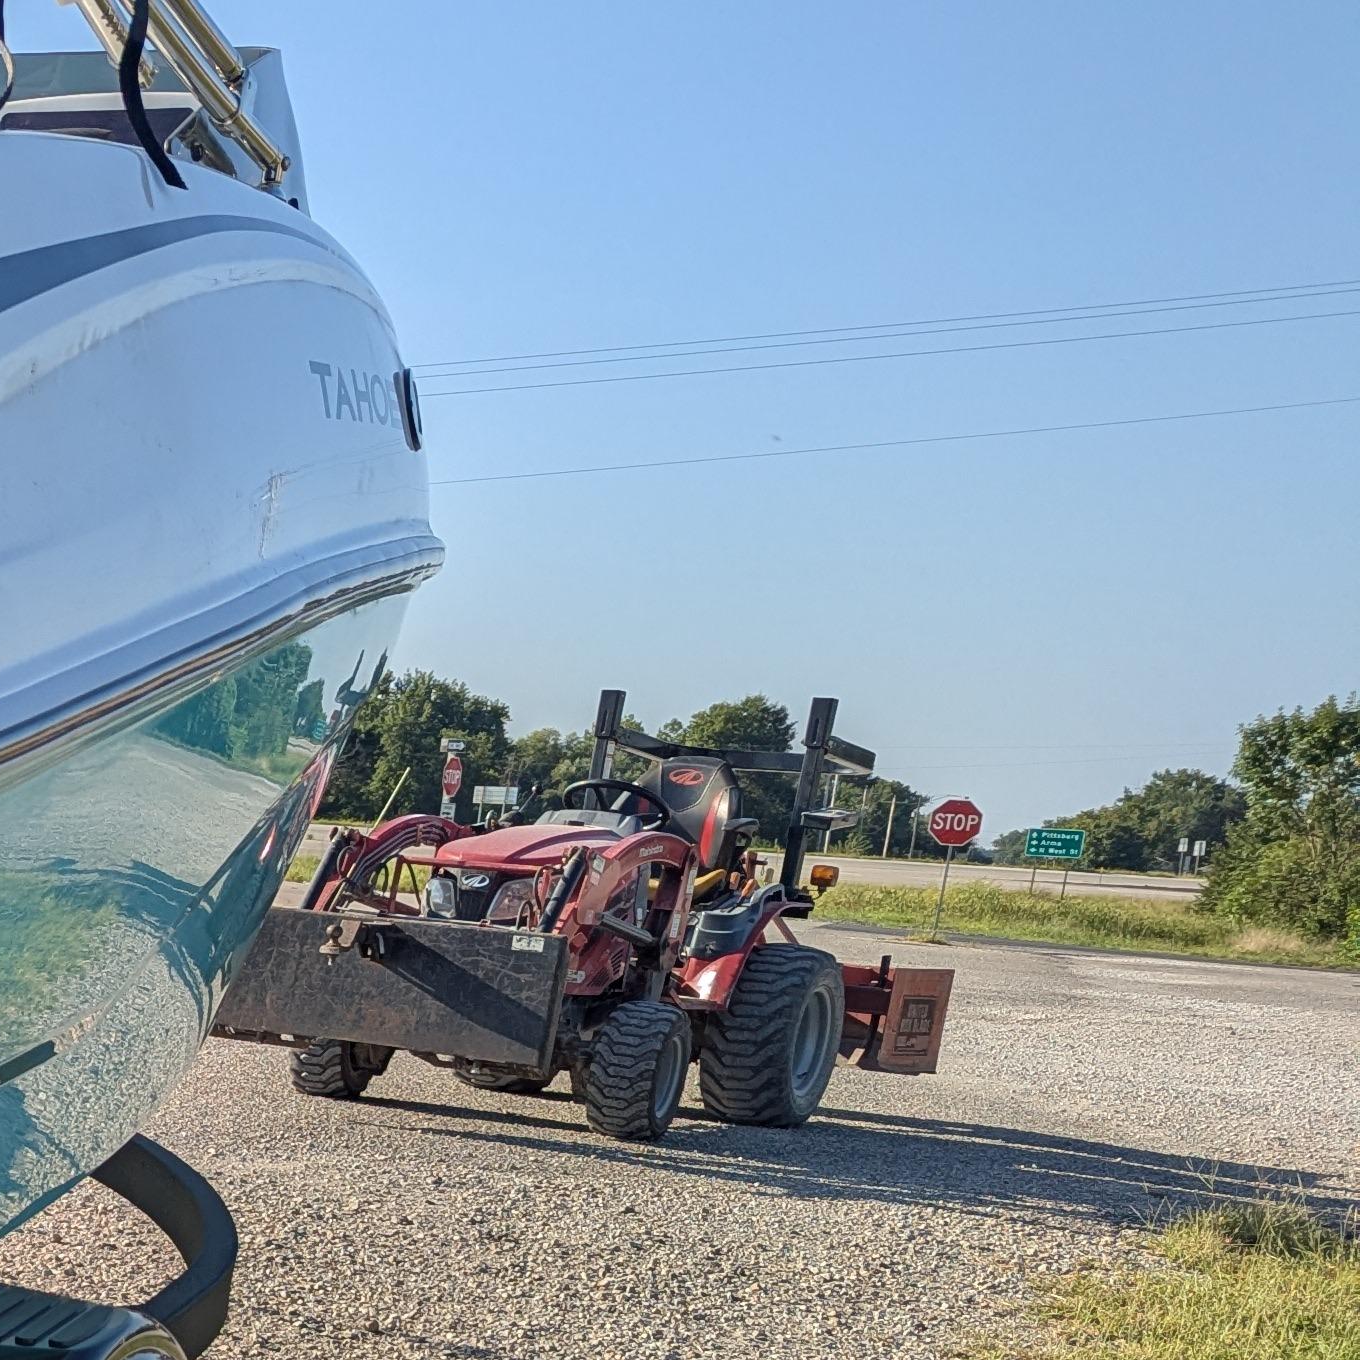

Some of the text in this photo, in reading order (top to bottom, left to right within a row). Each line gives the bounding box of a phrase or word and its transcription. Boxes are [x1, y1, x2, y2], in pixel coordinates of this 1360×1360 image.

[444, 769, 461, 784] STOP
[933, 813, 979, 832] STOP
[1041, 832, 1080, 841] Pittsburg
